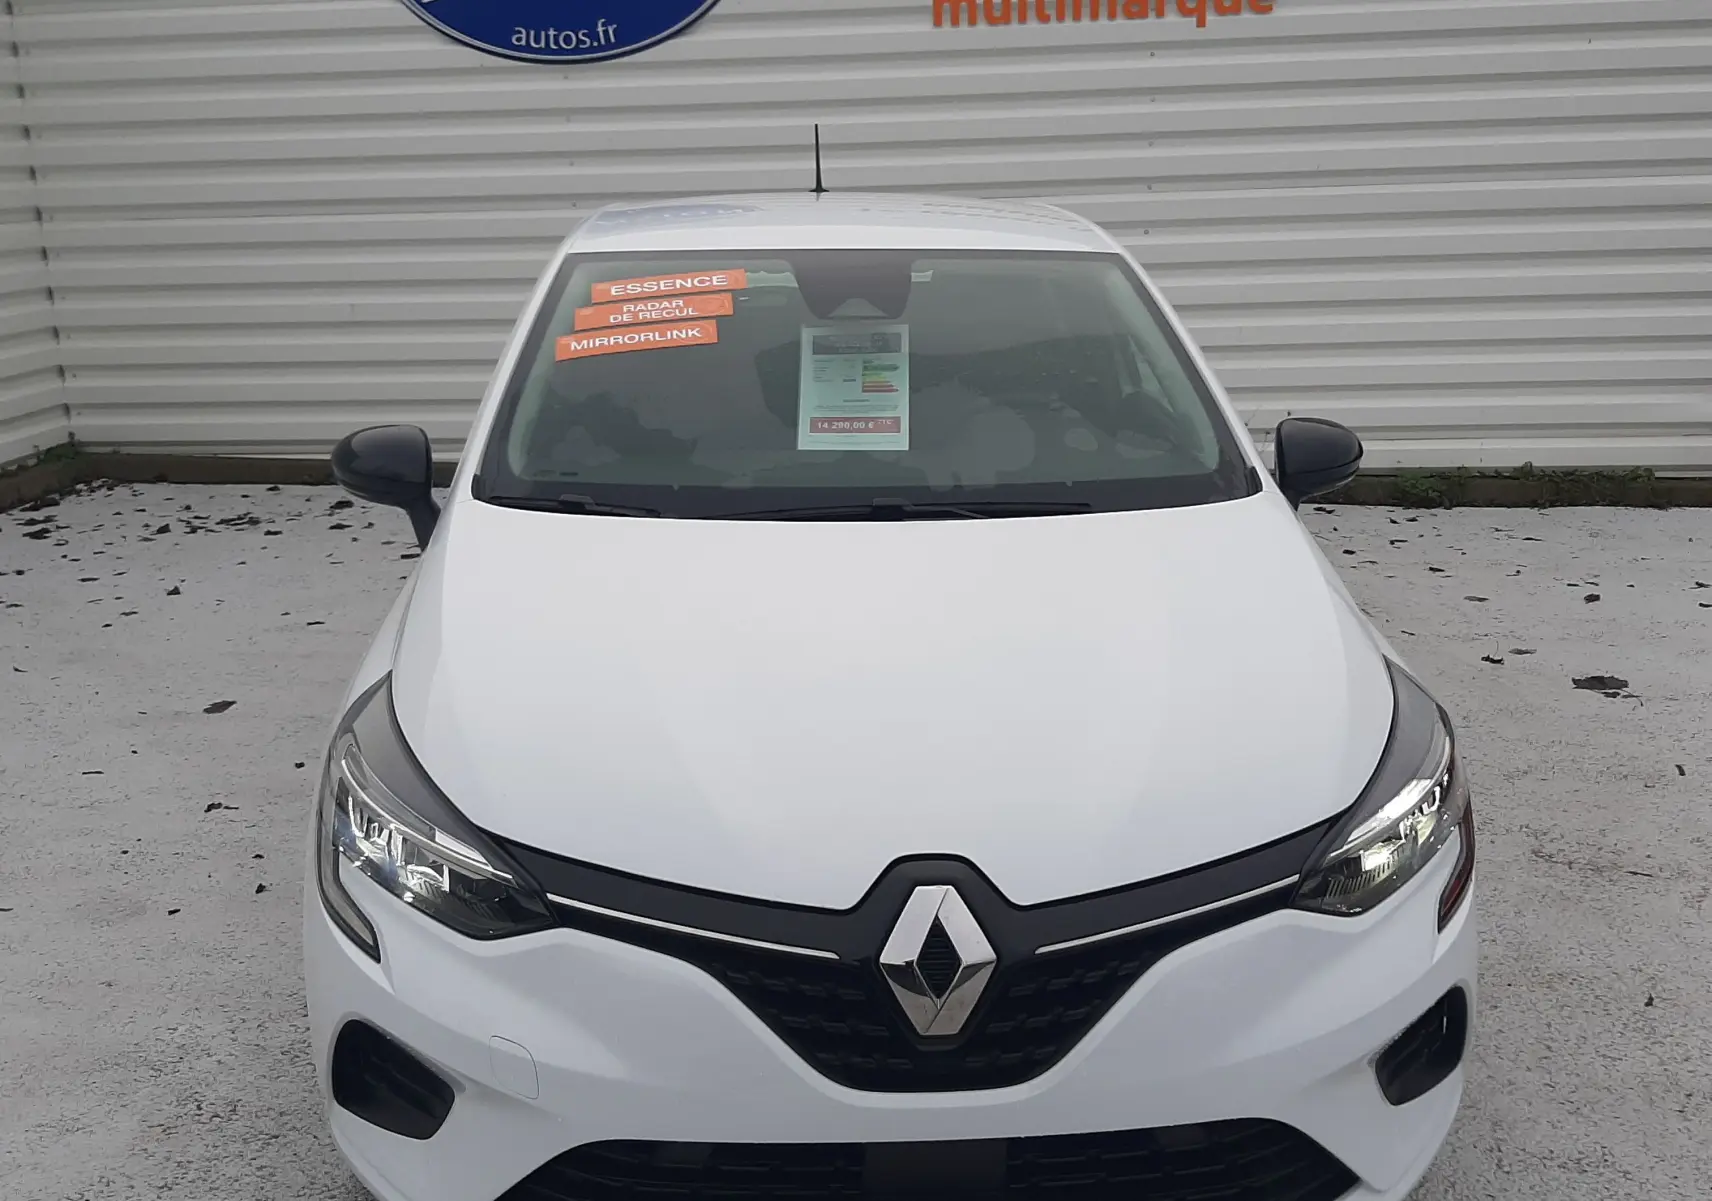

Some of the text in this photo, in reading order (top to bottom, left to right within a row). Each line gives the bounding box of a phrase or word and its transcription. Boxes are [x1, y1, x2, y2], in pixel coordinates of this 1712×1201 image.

[511, 18, 618, 50] autos.fr
[610, 275, 728, 297] ESSENCE
[610, 307, 699, 323] DE RECUL
[623, 300, 684, 313] RADAR
[570, 327, 702, 351] MIRRORLINK
[818, 421, 828, 429] 14
